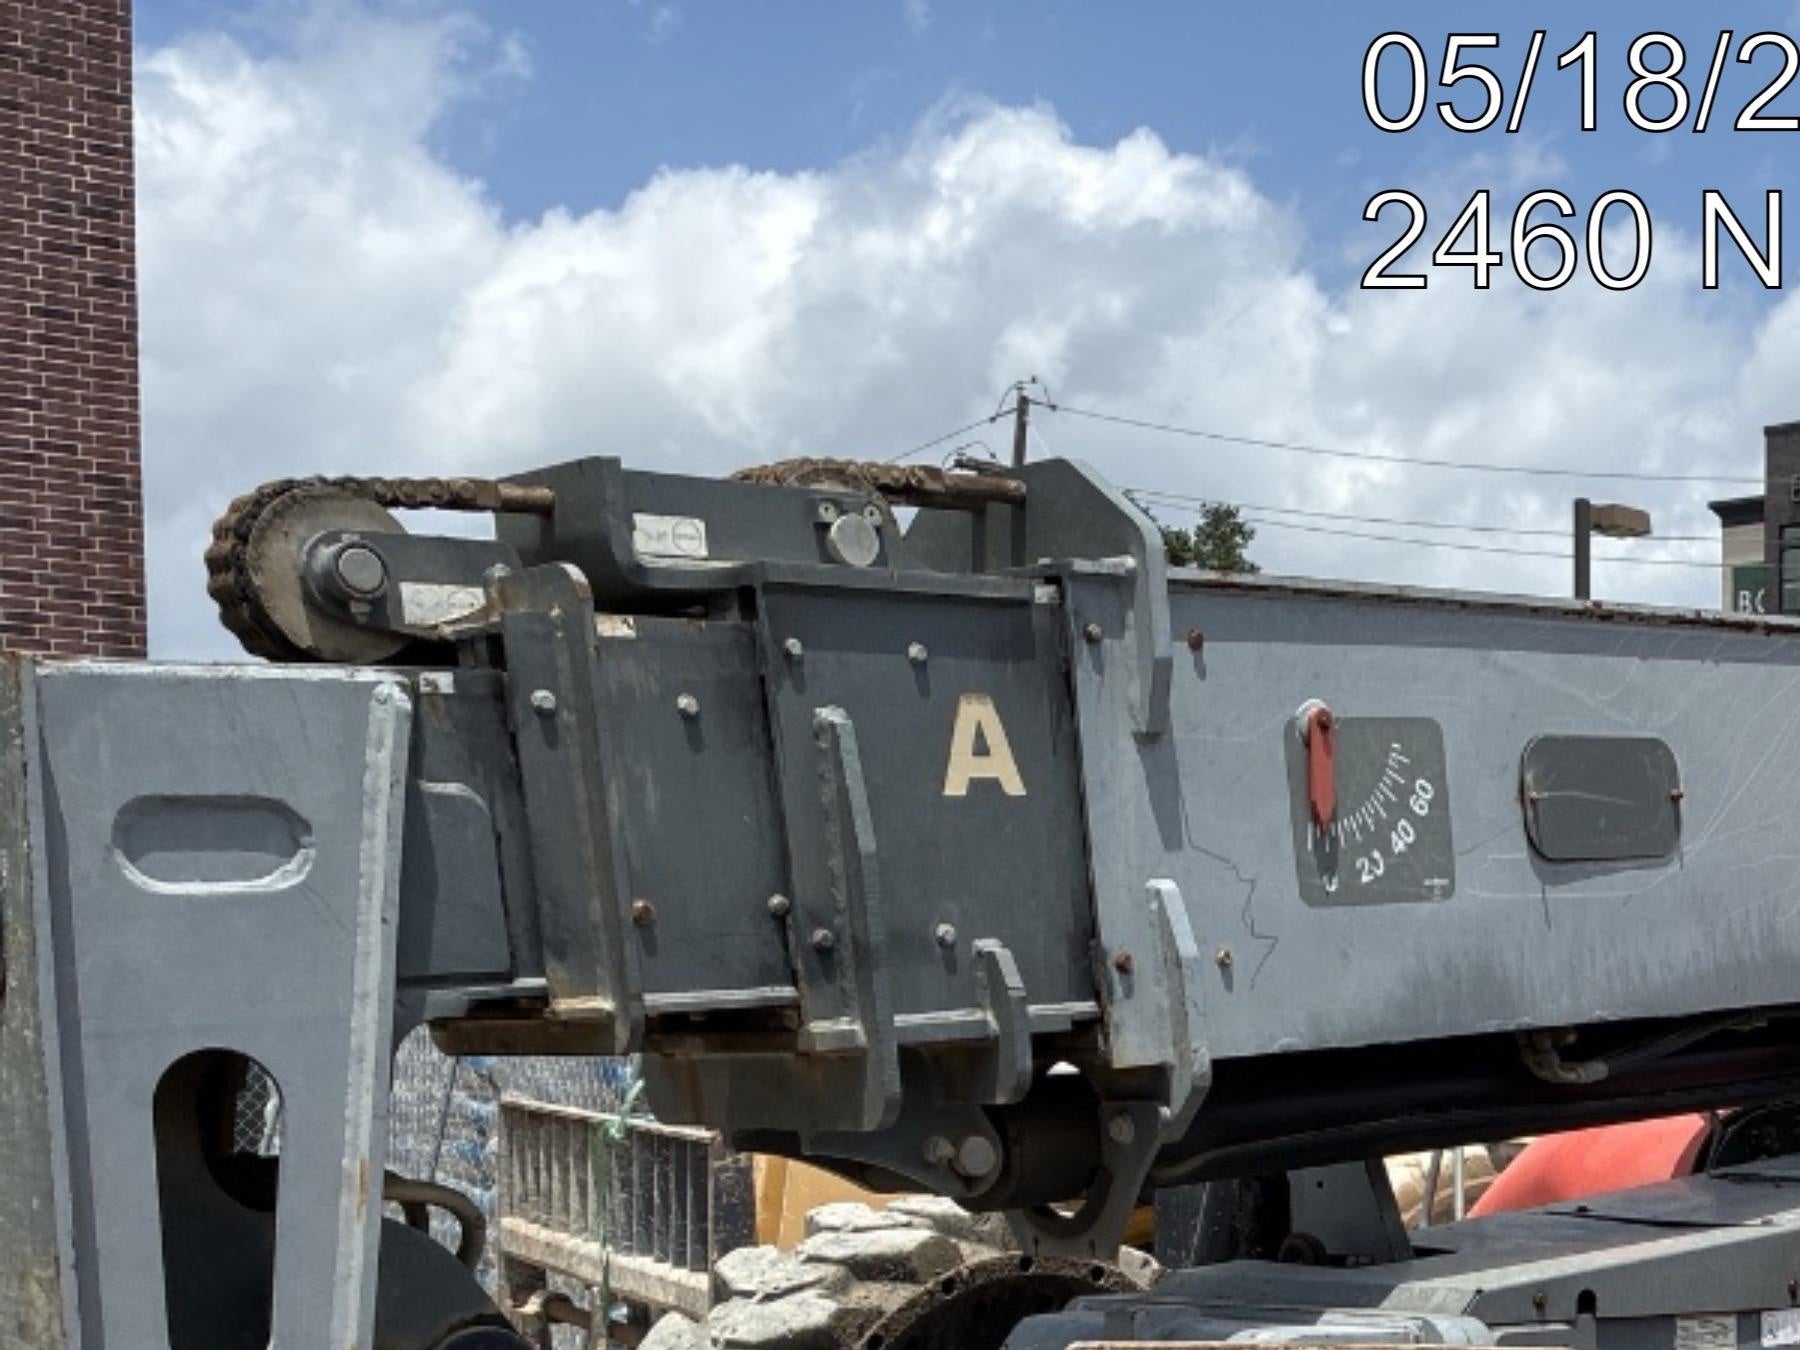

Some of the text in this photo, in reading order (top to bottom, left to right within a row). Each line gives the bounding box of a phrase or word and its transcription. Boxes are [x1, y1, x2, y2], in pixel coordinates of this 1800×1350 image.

[942, 692, 1027, 797] A
[1355, 849, 1385, 885] 20
[1390, 817, 1416, 855] 40
[1408, 778, 1435, 817] 60
